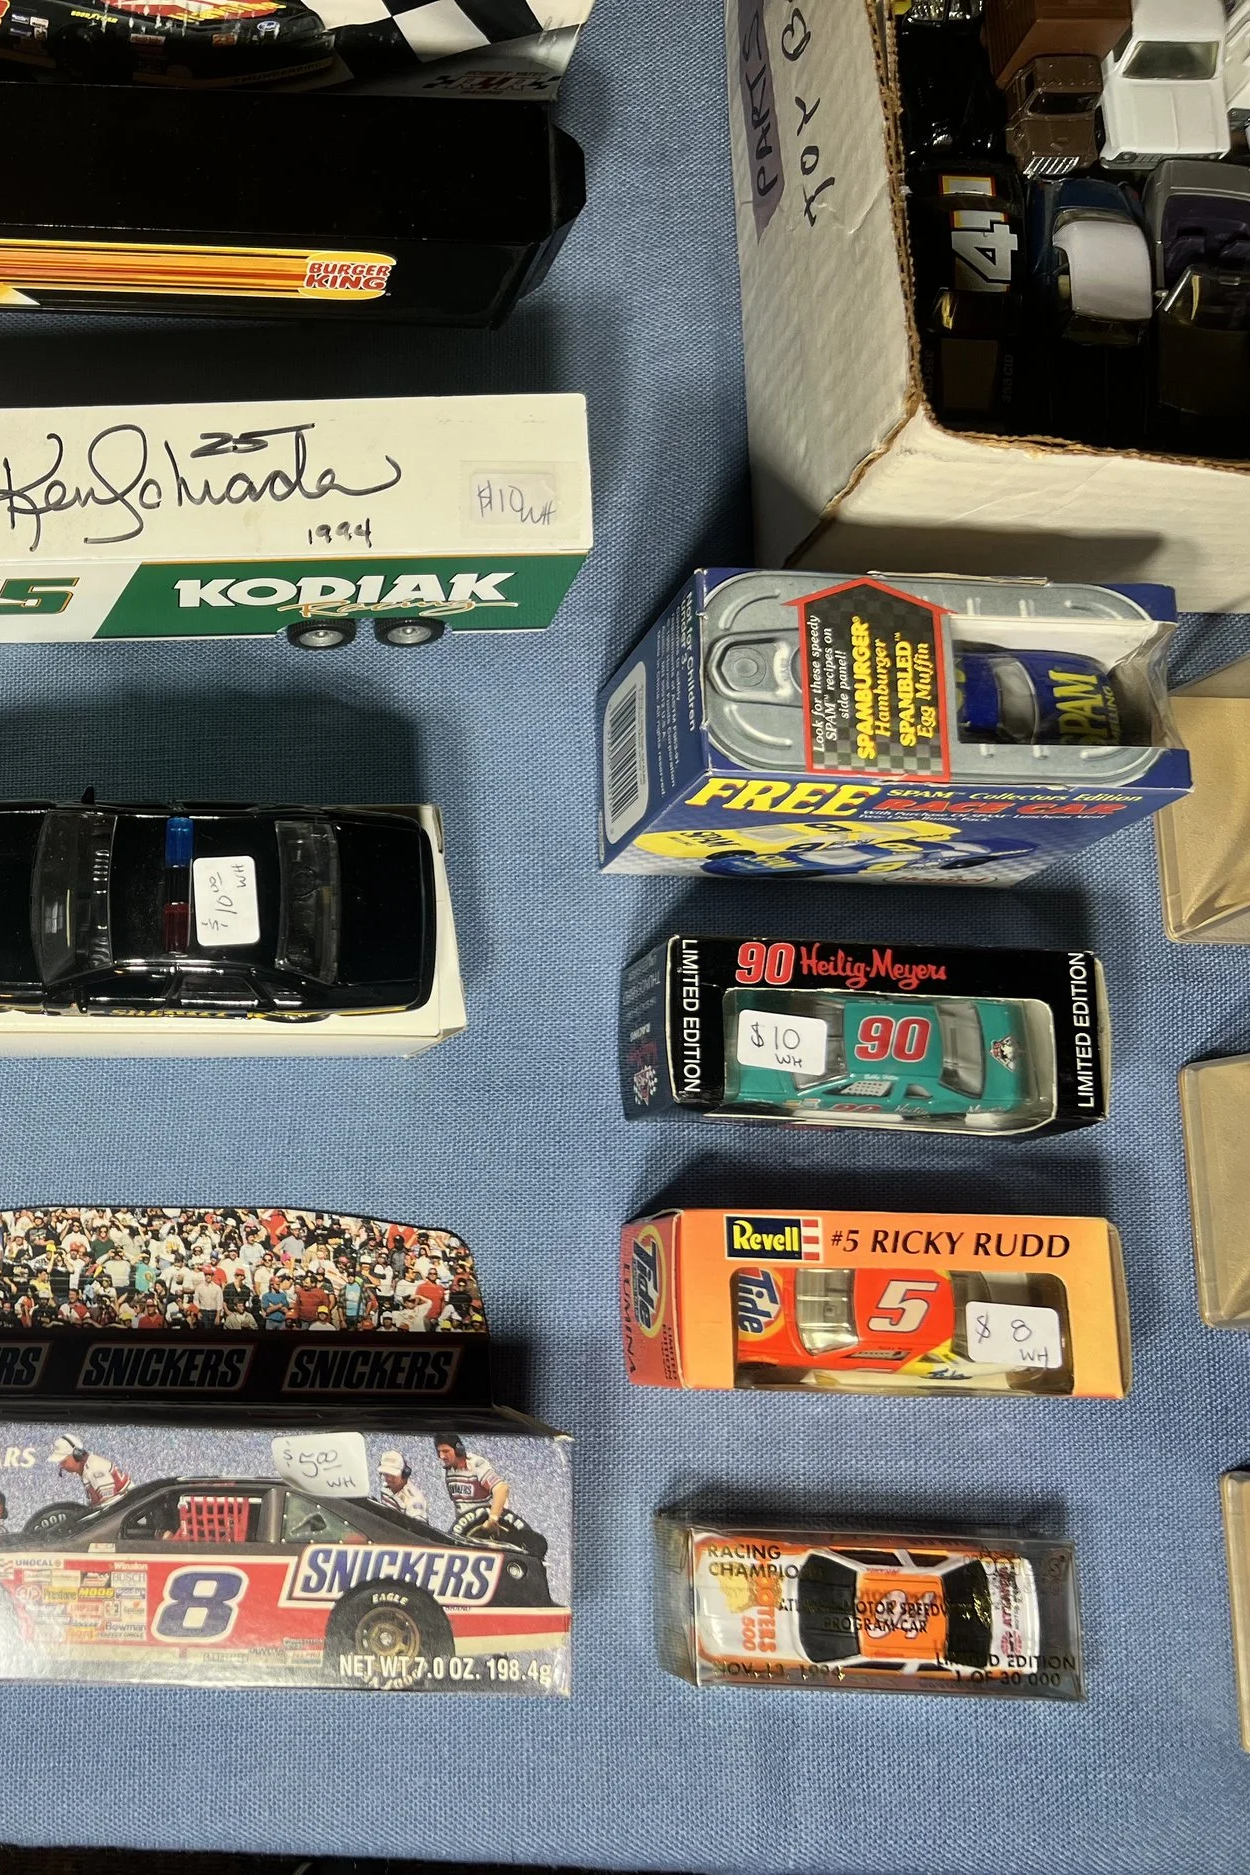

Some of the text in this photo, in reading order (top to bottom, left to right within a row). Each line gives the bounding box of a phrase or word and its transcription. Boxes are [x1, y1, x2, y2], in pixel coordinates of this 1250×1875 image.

[741, 9, 779, 197] PARTS
[794, 96, 836, 228] TOY
[303, 273, 388, 291] KING
[307, 261, 392, 278] BURGER
[173, 571, 518, 609] KODIAK
[685, 655, 696, 732] Children
[807, 614, 826, 753] Look for these speedy
[823, 627, 838, 742] SPAM recipes on
[837, 650, 852, 719] side panel!
[850, 620, 877, 761] SPAMBURGER
[873, 638, 893, 738] Hamburger
[895, 639, 918, 748] SPAMBLED
[914, 642, 937, 739] Egg Muffin
[684, 777, 882, 817] FREE
[871, 798, 1129, 815] RACE CAR
[886, 788, 1144, 802] SPAM Collectors Edition
[734, 941, 948, 991] 90 Heilig-Meyers
[681, 939, 701, 1094] LIMITED EDITION
[853, 1015, 933, 1062] 90
[1067, 952, 1095, 1108] LIMITED EDITION
[732, 1219, 1071, 1259] Revell #5 RICKY RUDD
[631, 1239, 659, 1329] Tide
[736, 1268, 782, 1336] Tide
[866, 1280, 939, 1334] 5
[622, 1263, 637, 1375] LUMINA
[81, 1345, 244, 1389] SNICKERS
[284, 1347, 456, 1391] SNICKERS
[14, 1559, 54, 1567] UNOCAL
[299, 1546, 499, 1602] SNICKERS
[707, 1543, 781, 1560] RACING
[78, 1587, 115, 1598] MOOG
[151, 1566, 249, 1644] 8
[370, 1591, 410, 1607] EAGLE
[105, 1621, 147, 1632] Bowman
[902, 1619, 929, 1634] CAR
[339, 1655, 554, 1686] NET WT 7.0 OZ. 198.4g
[1007, 1654, 1077, 1671] EDITION
